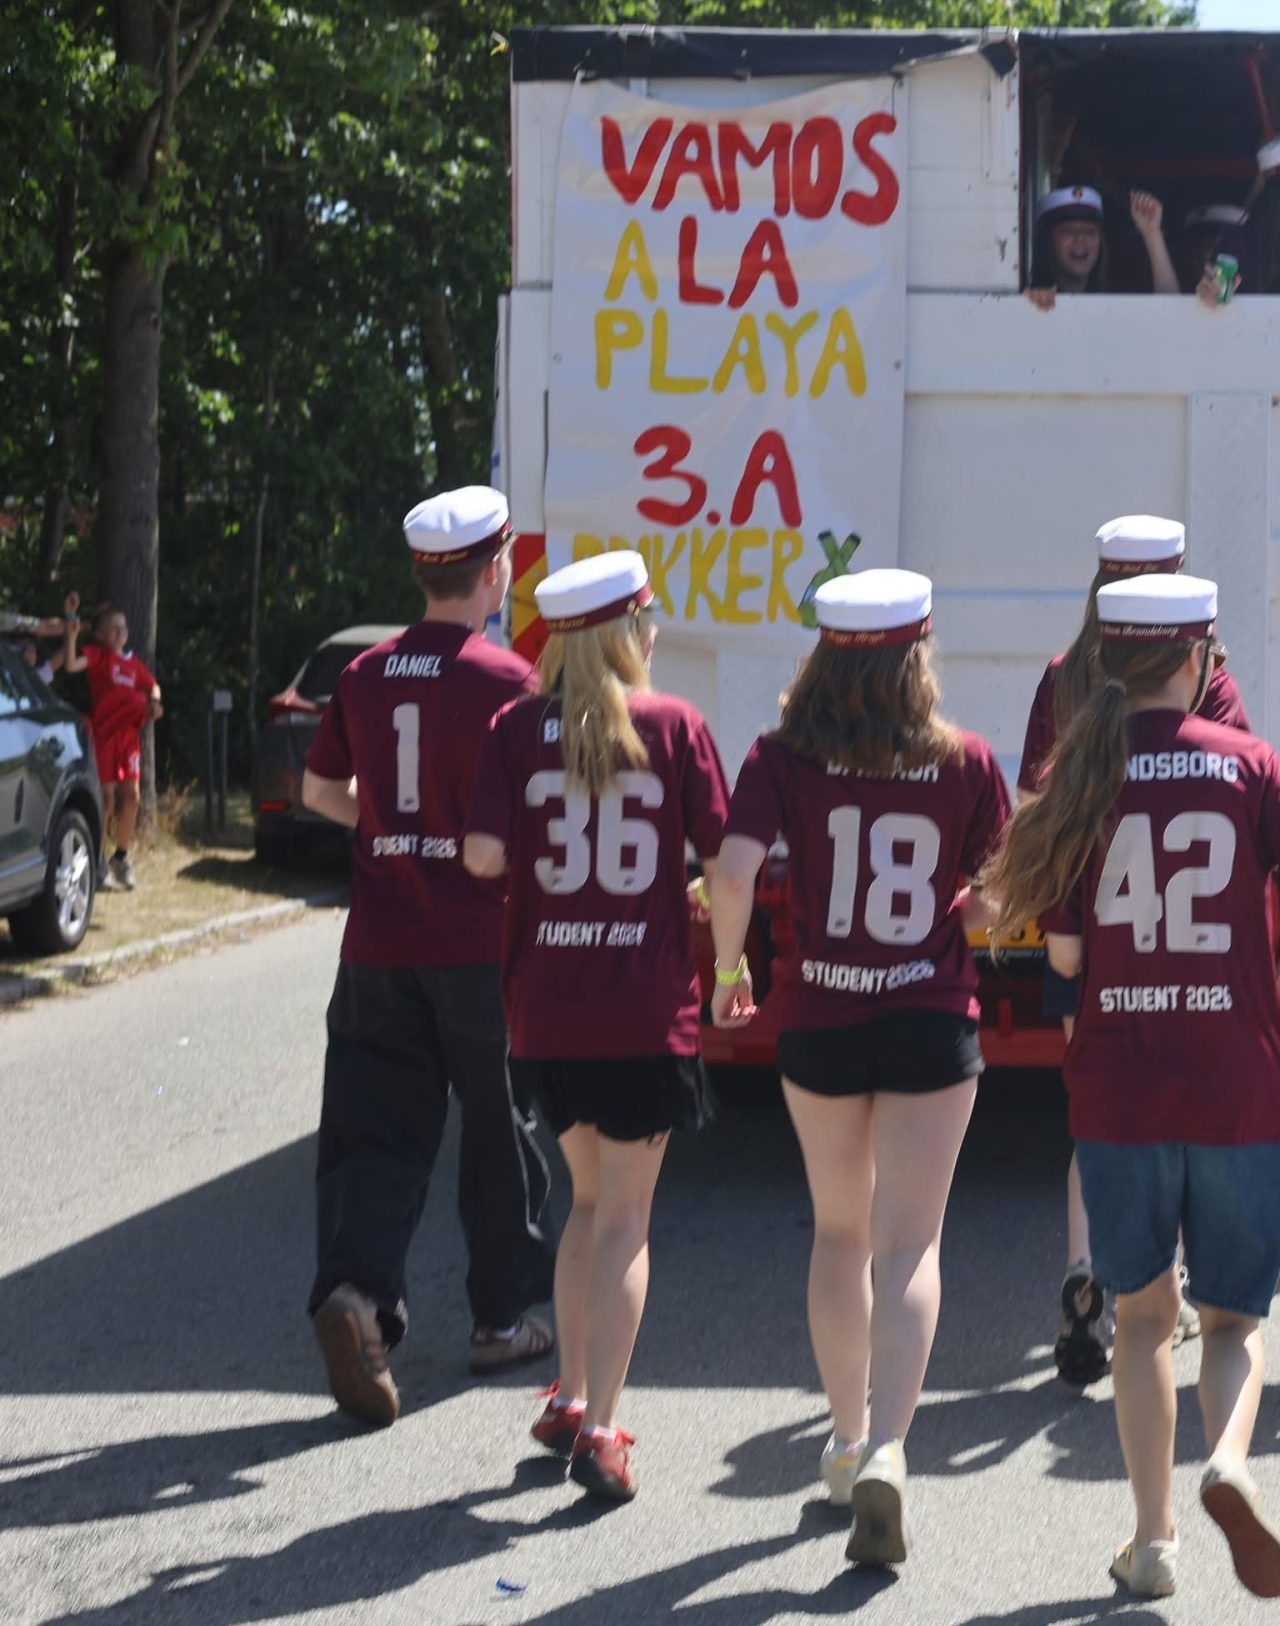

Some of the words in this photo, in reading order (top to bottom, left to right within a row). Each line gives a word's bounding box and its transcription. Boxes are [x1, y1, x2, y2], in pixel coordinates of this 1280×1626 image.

[601, 112, 900, 226] VAMOS
[604, 219, 658, 302] A
[679, 215, 799, 309] LA
[595, 307, 867, 398] PLAYA
[634, 424, 803, 528] 3.A
[384, 654, 442, 678] DANIEL
[392, 703, 420, 813] 1
[1124, 750, 1239, 784] NDSBORG
[525, 769, 665, 895] 36
[826, 805, 941, 946] 18
[1094, 811, 1237, 954] 42
[535, 921, 606, 948] TUDENT
[801, 959, 888, 995] STUDENT
